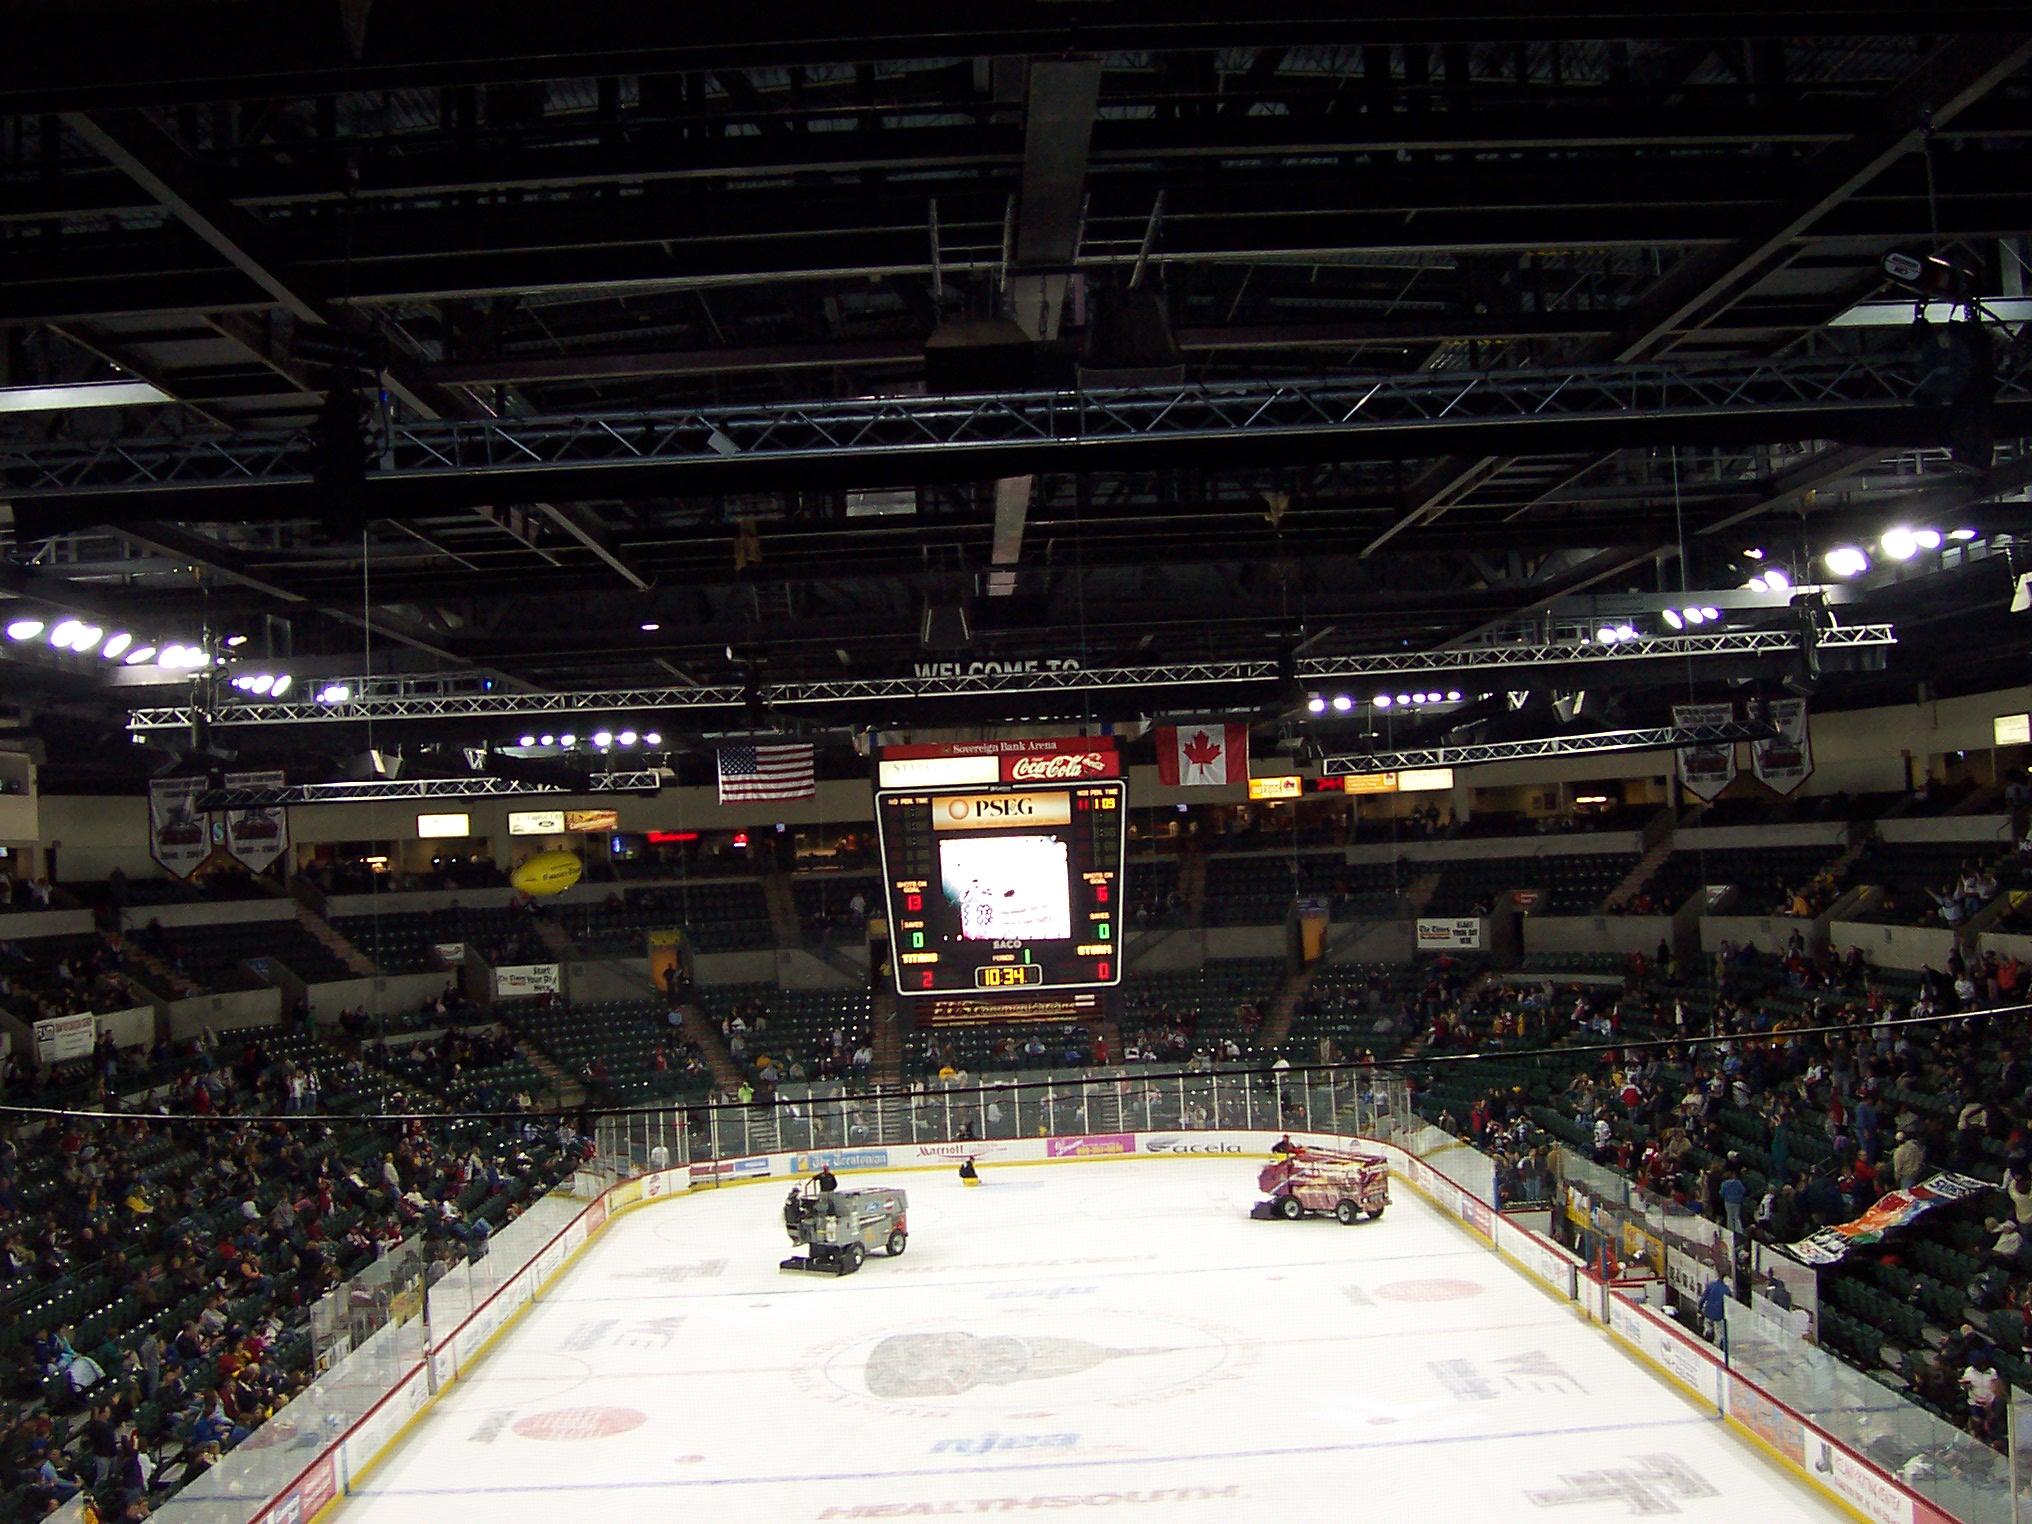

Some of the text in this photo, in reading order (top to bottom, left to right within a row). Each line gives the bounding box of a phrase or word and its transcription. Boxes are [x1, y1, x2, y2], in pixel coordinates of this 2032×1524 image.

[914, 658, 1080, 678] WELCOME TO
[953, 740, 1057, 755] Sovereign Bank Arena
[976, 798, 1033, 818] PSEG
[907, 895, 923, 911] 13
[1098, 924, 1110, 939] 0
[912, 932, 924, 948] 0
[993, 940, 1022, 949] SACO
[1023, 949, 1031, 965] 1
[984, 967, 1025, 986] 10:34
[1097, 962, 1110, 979] 0
[922, 970, 934, 988] 2
[916, 1144, 964, 1157] Marriott
[1172, 1141, 1242, 1154] acela
